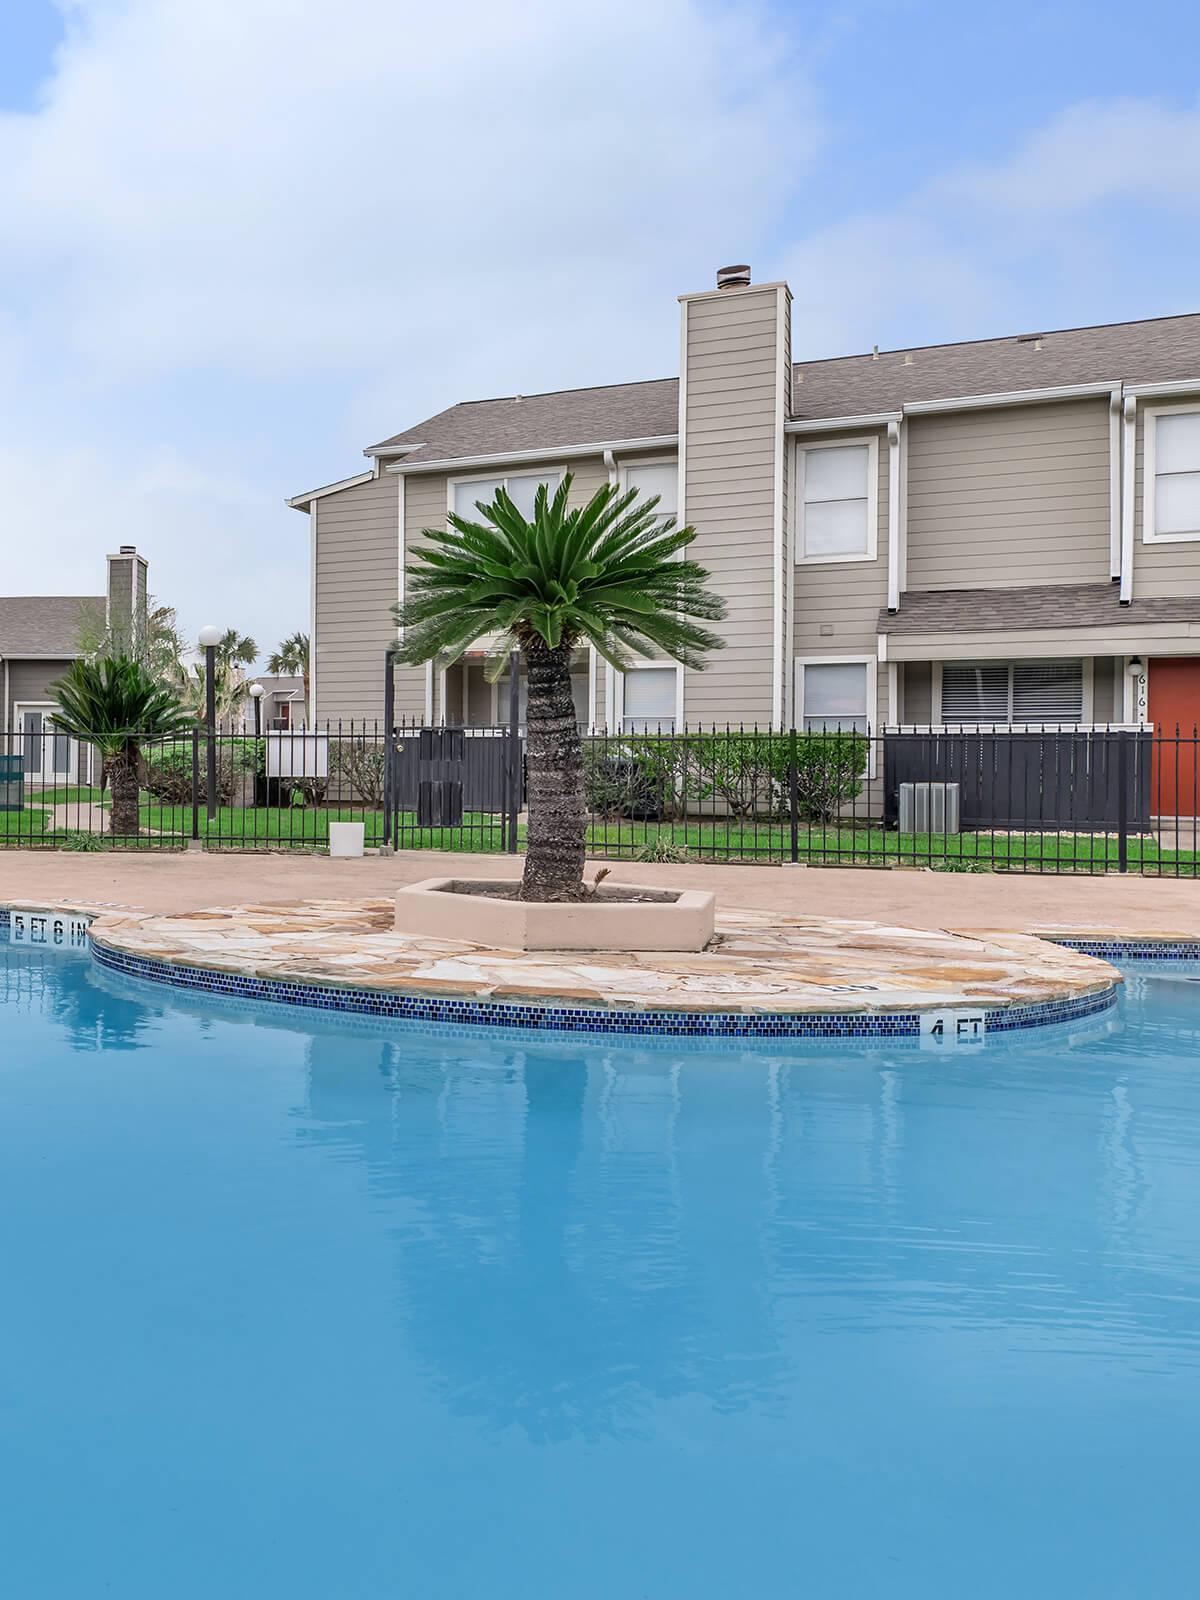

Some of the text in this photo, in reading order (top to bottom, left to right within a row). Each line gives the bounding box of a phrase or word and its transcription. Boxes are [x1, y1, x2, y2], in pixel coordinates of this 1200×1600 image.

[1138, 674, 1146, 707] 616
[15, 916, 86, 938] 5 FT 6 IN
[956, 1017, 983, 1035] FT
